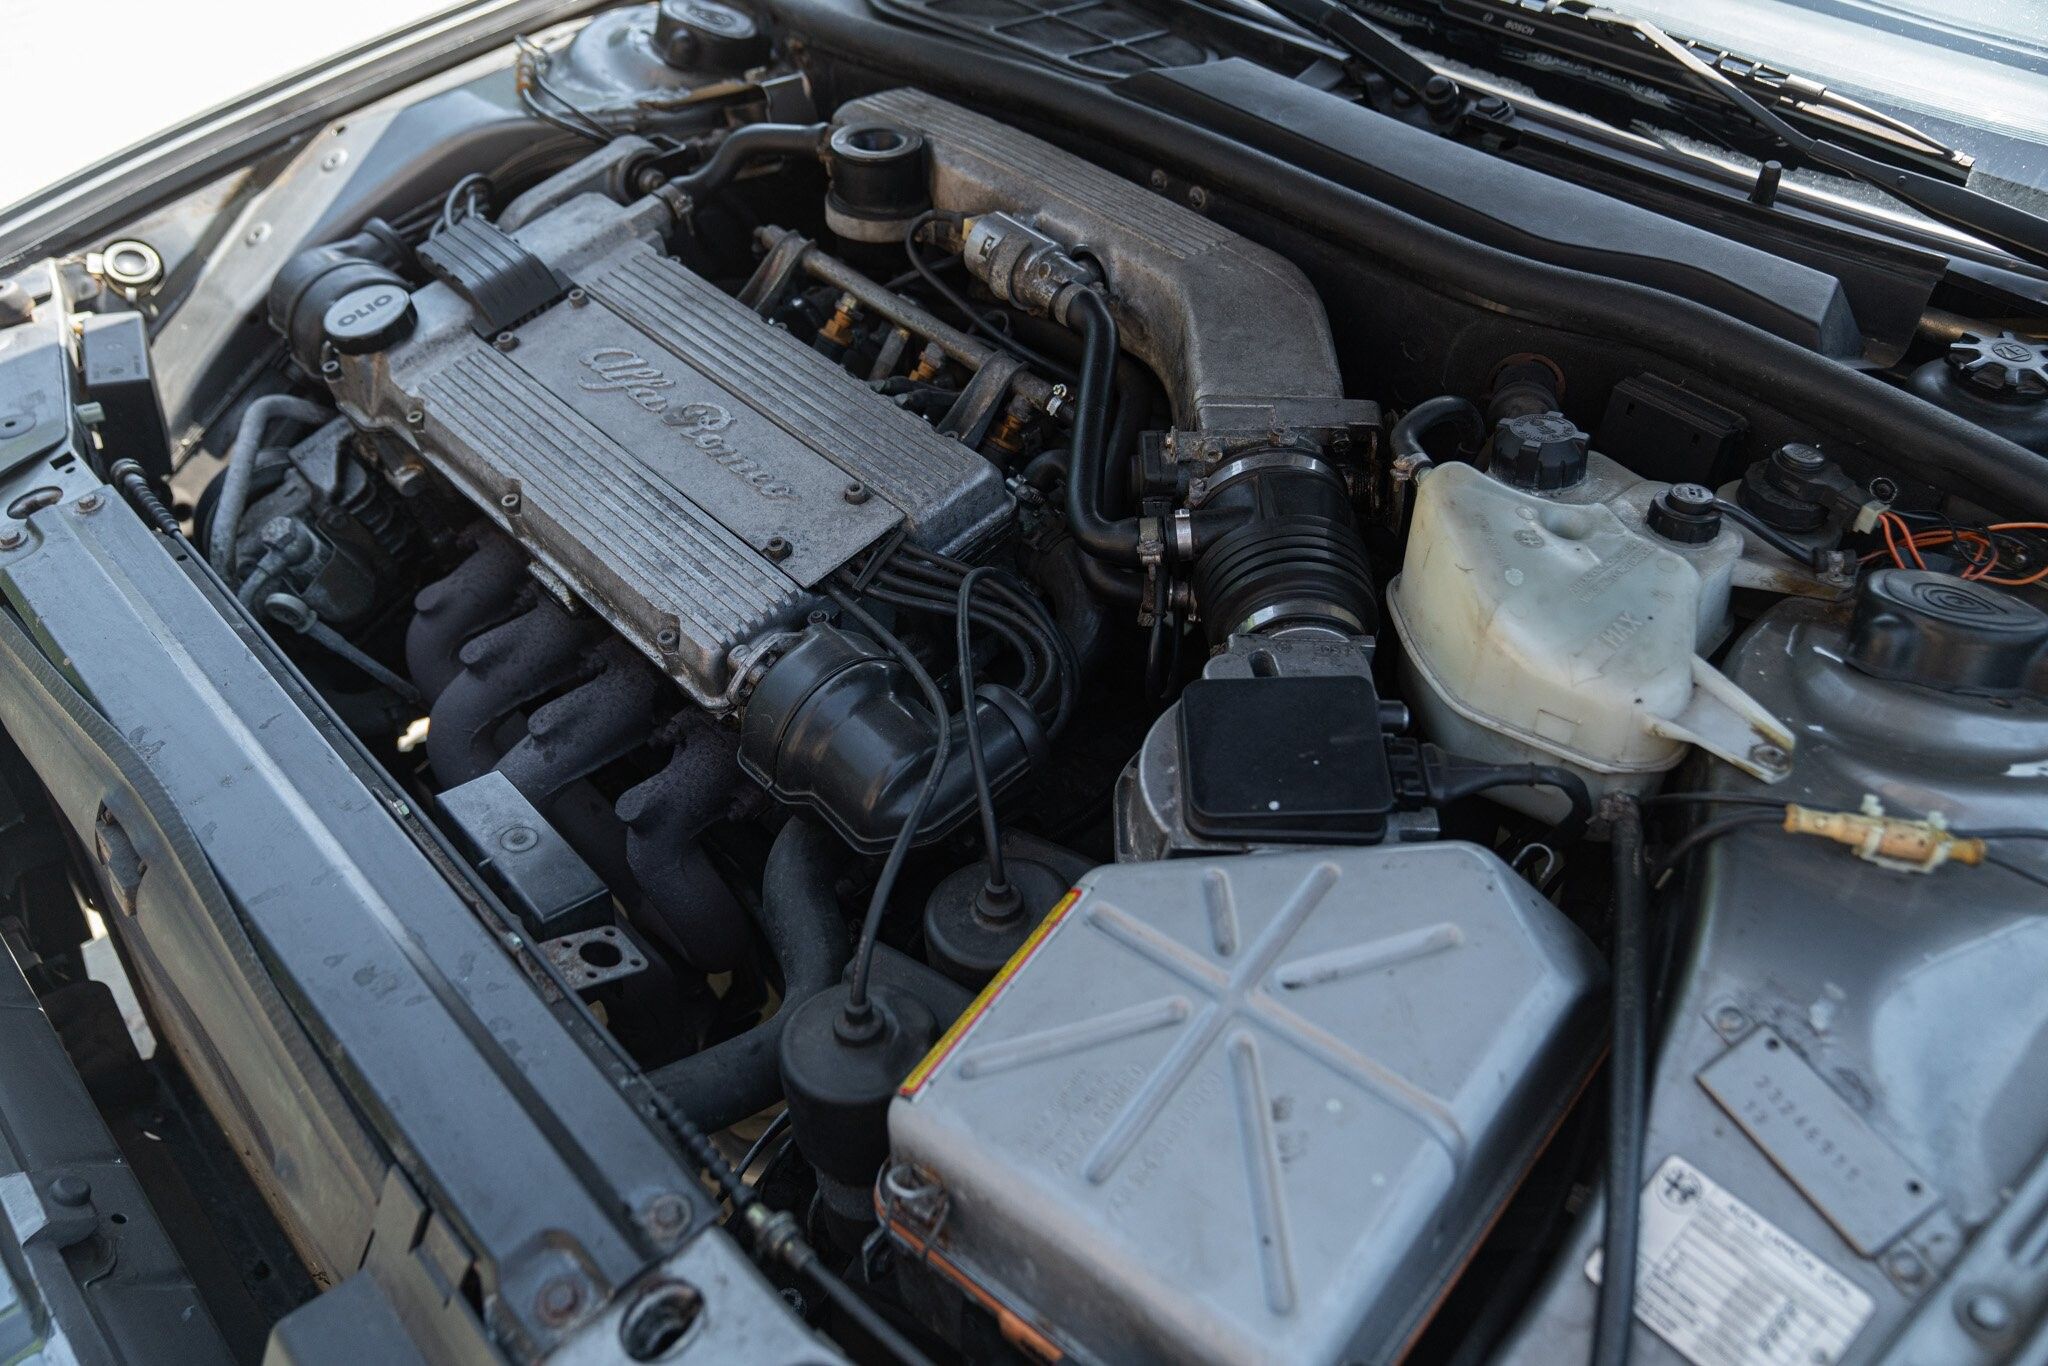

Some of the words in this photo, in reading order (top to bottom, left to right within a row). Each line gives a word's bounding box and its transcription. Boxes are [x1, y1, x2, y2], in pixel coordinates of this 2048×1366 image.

[1504, 20, 1536, 36] BOSCH
[337, 294, 393, 327] OLIO
[577, 347, 677, 414] Alfa
[662, 402, 801, 500] Romeo
[1601, 610, 1643, 648] MAX
